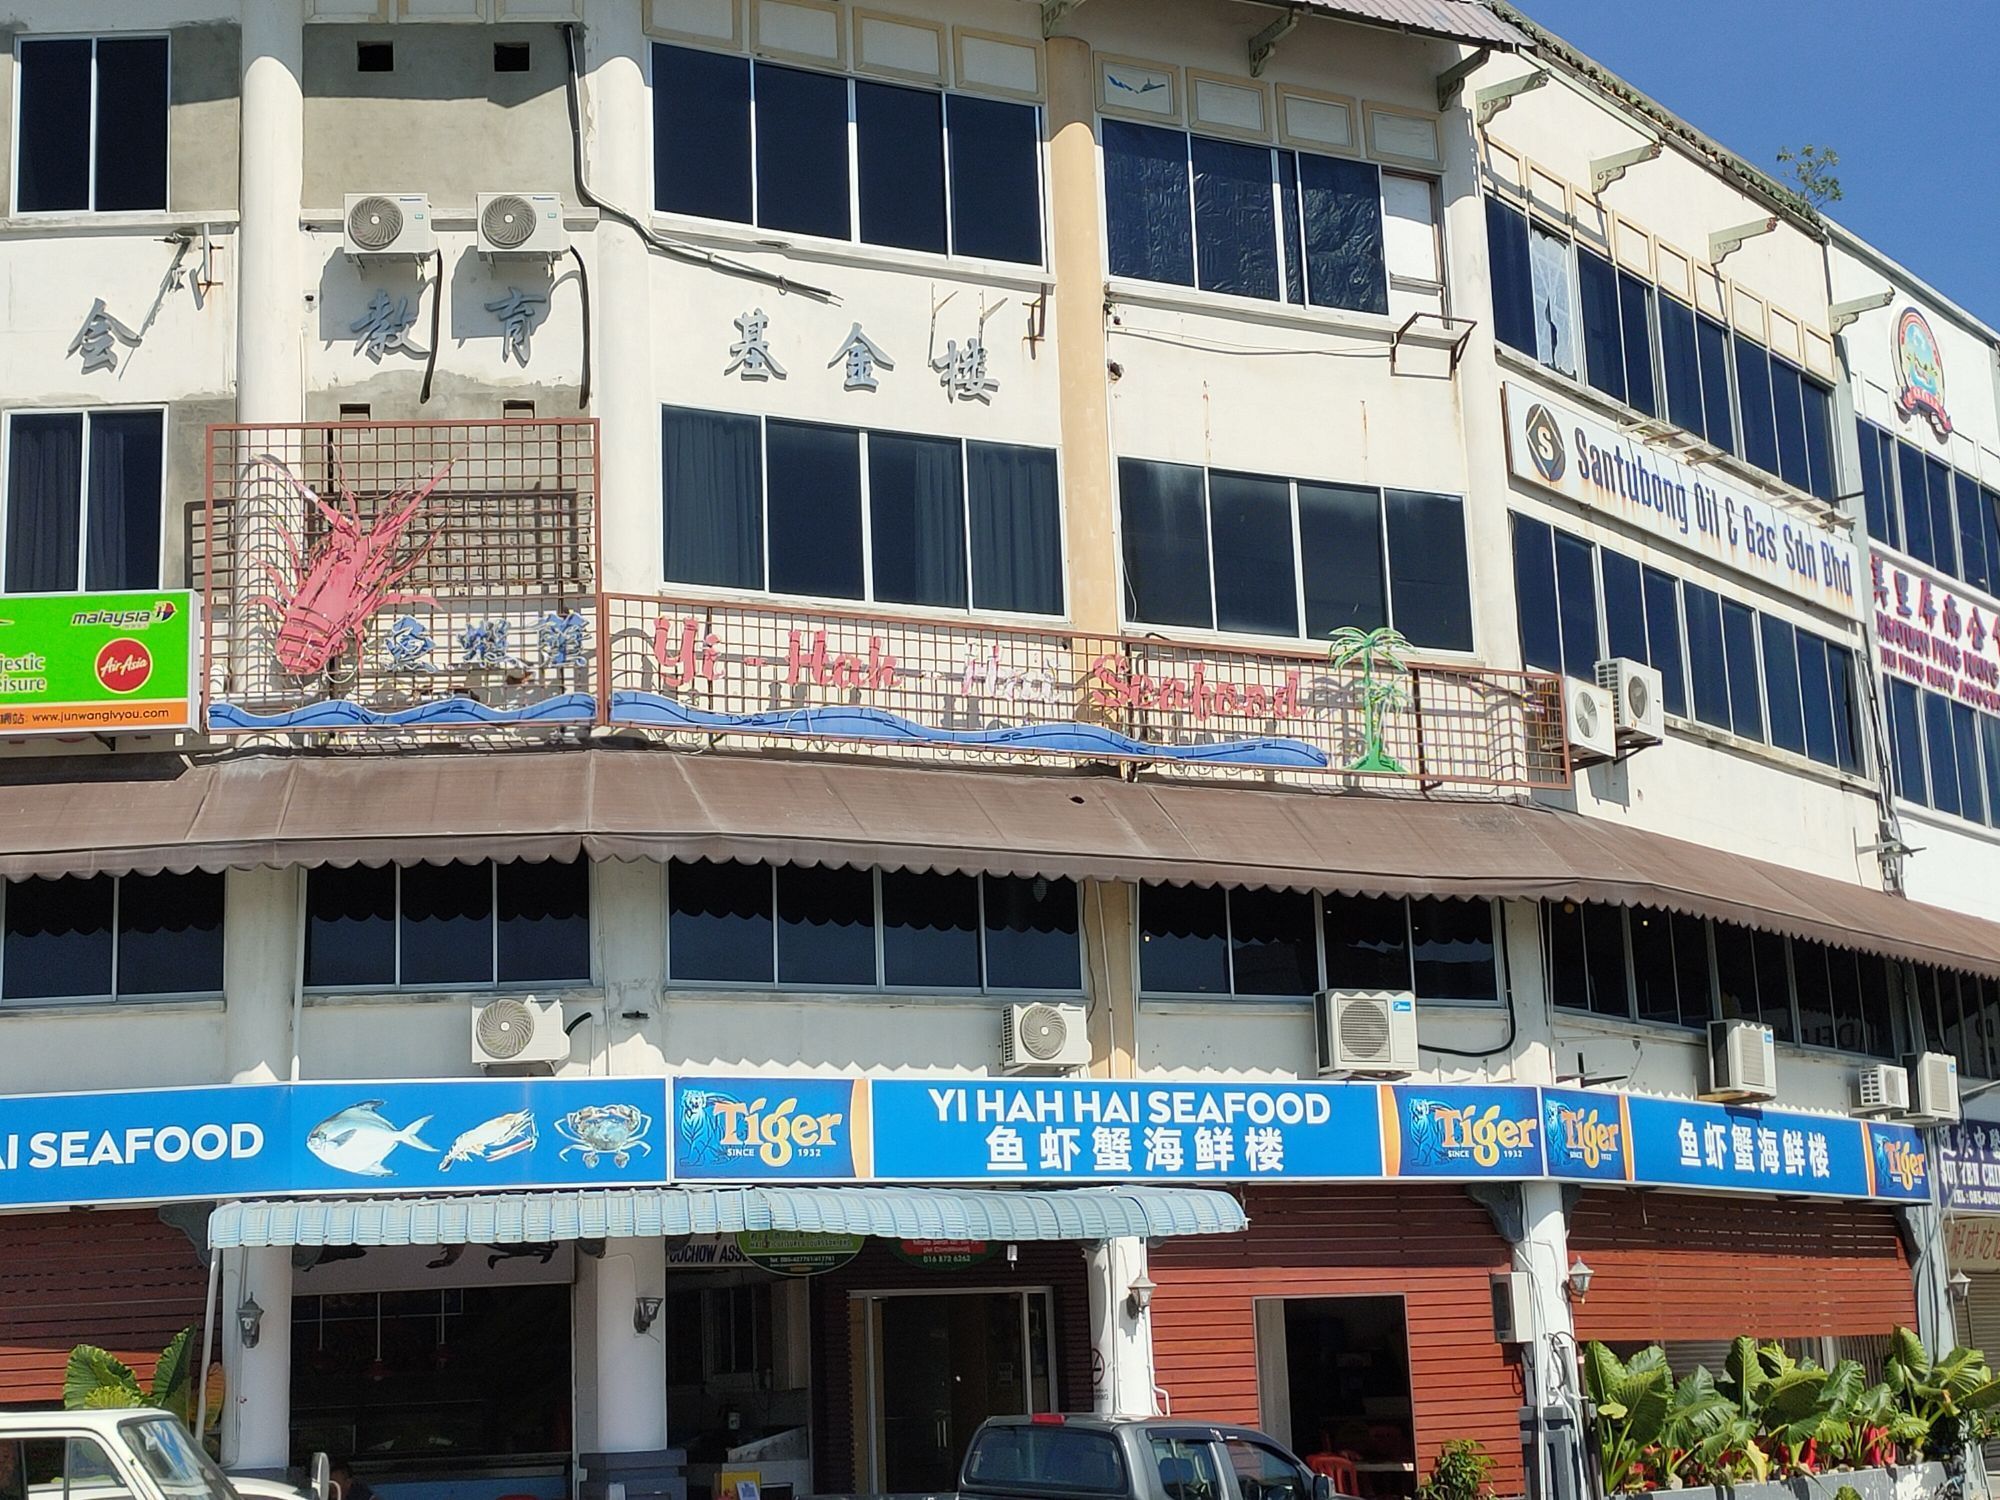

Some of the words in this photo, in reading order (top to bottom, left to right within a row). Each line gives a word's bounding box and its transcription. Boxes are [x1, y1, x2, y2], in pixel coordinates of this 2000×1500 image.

[1574, 427, 1688, 534] Santubong
[1694, 482, 1720, 538] Oil
[1744, 505, 1777, 563] Gas
[1783, 524, 1818, 582] Sdn
[1820, 541, 1854, 597] Bhd
[72, 610, 150, 627] malaysia
[32, 709, 169, 723] www.junwanglvyou.com
[928, 1089, 967, 1122] YI
[977, 1089, 1063, 1123] HAH
[1073, 1090, 1140, 1123] HAI
[1149, 1091, 1331, 1125] SEAFOOD
[29, 1123, 265, 1169] SEAFOOD
[713, 1098, 842, 1167] Tiger
[727, 1148, 754, 1157] SINCE
[798, 1148, 821, 1157] 1932
[985, 1125, 1285, 1173] 鱼虾蟹海鲜楼
[1434, 1105, 1538, 1167] Tiger
[1448, 1150, 1470, 1158] SINCE
[1561, 1107, 1618, 1169] Tiger
[1678, 1118, 1830, 1178] 鱼虾蟹海鲜楼
[1884, 1141, 1925, 1191] Tiger
